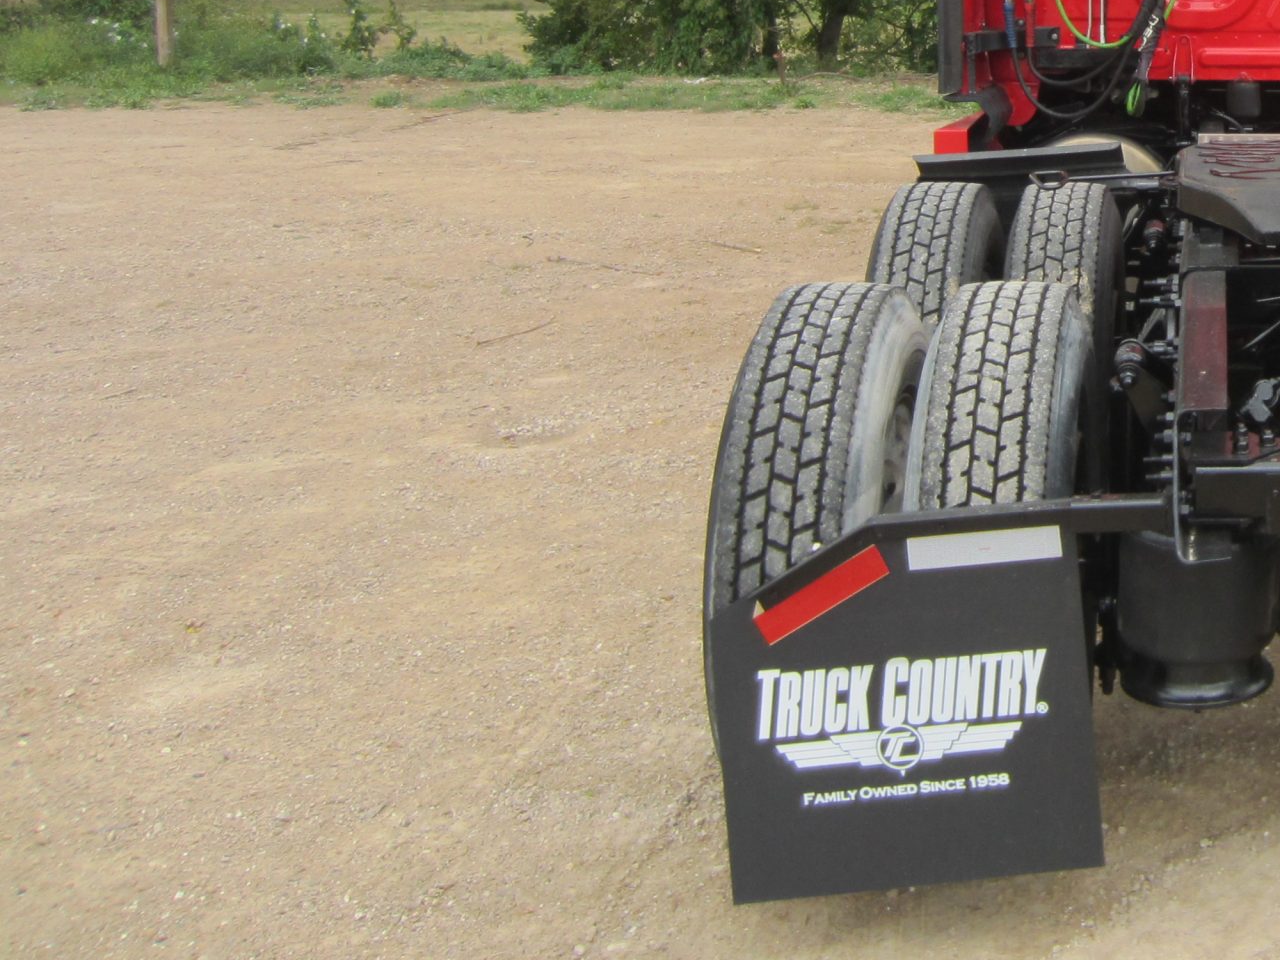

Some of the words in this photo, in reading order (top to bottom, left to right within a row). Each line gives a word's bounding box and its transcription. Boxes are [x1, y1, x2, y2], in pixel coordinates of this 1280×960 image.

[757, 664, 874, 740] TRUCK
[882, 648, 1047, 727] COUNTRY
[803, 789, 857, 806] FAMILY
[860, 784, 918, 799] OWNED
[920, 778, 966, 793] SINCE
[969, 773, 1010, 788] 1958
